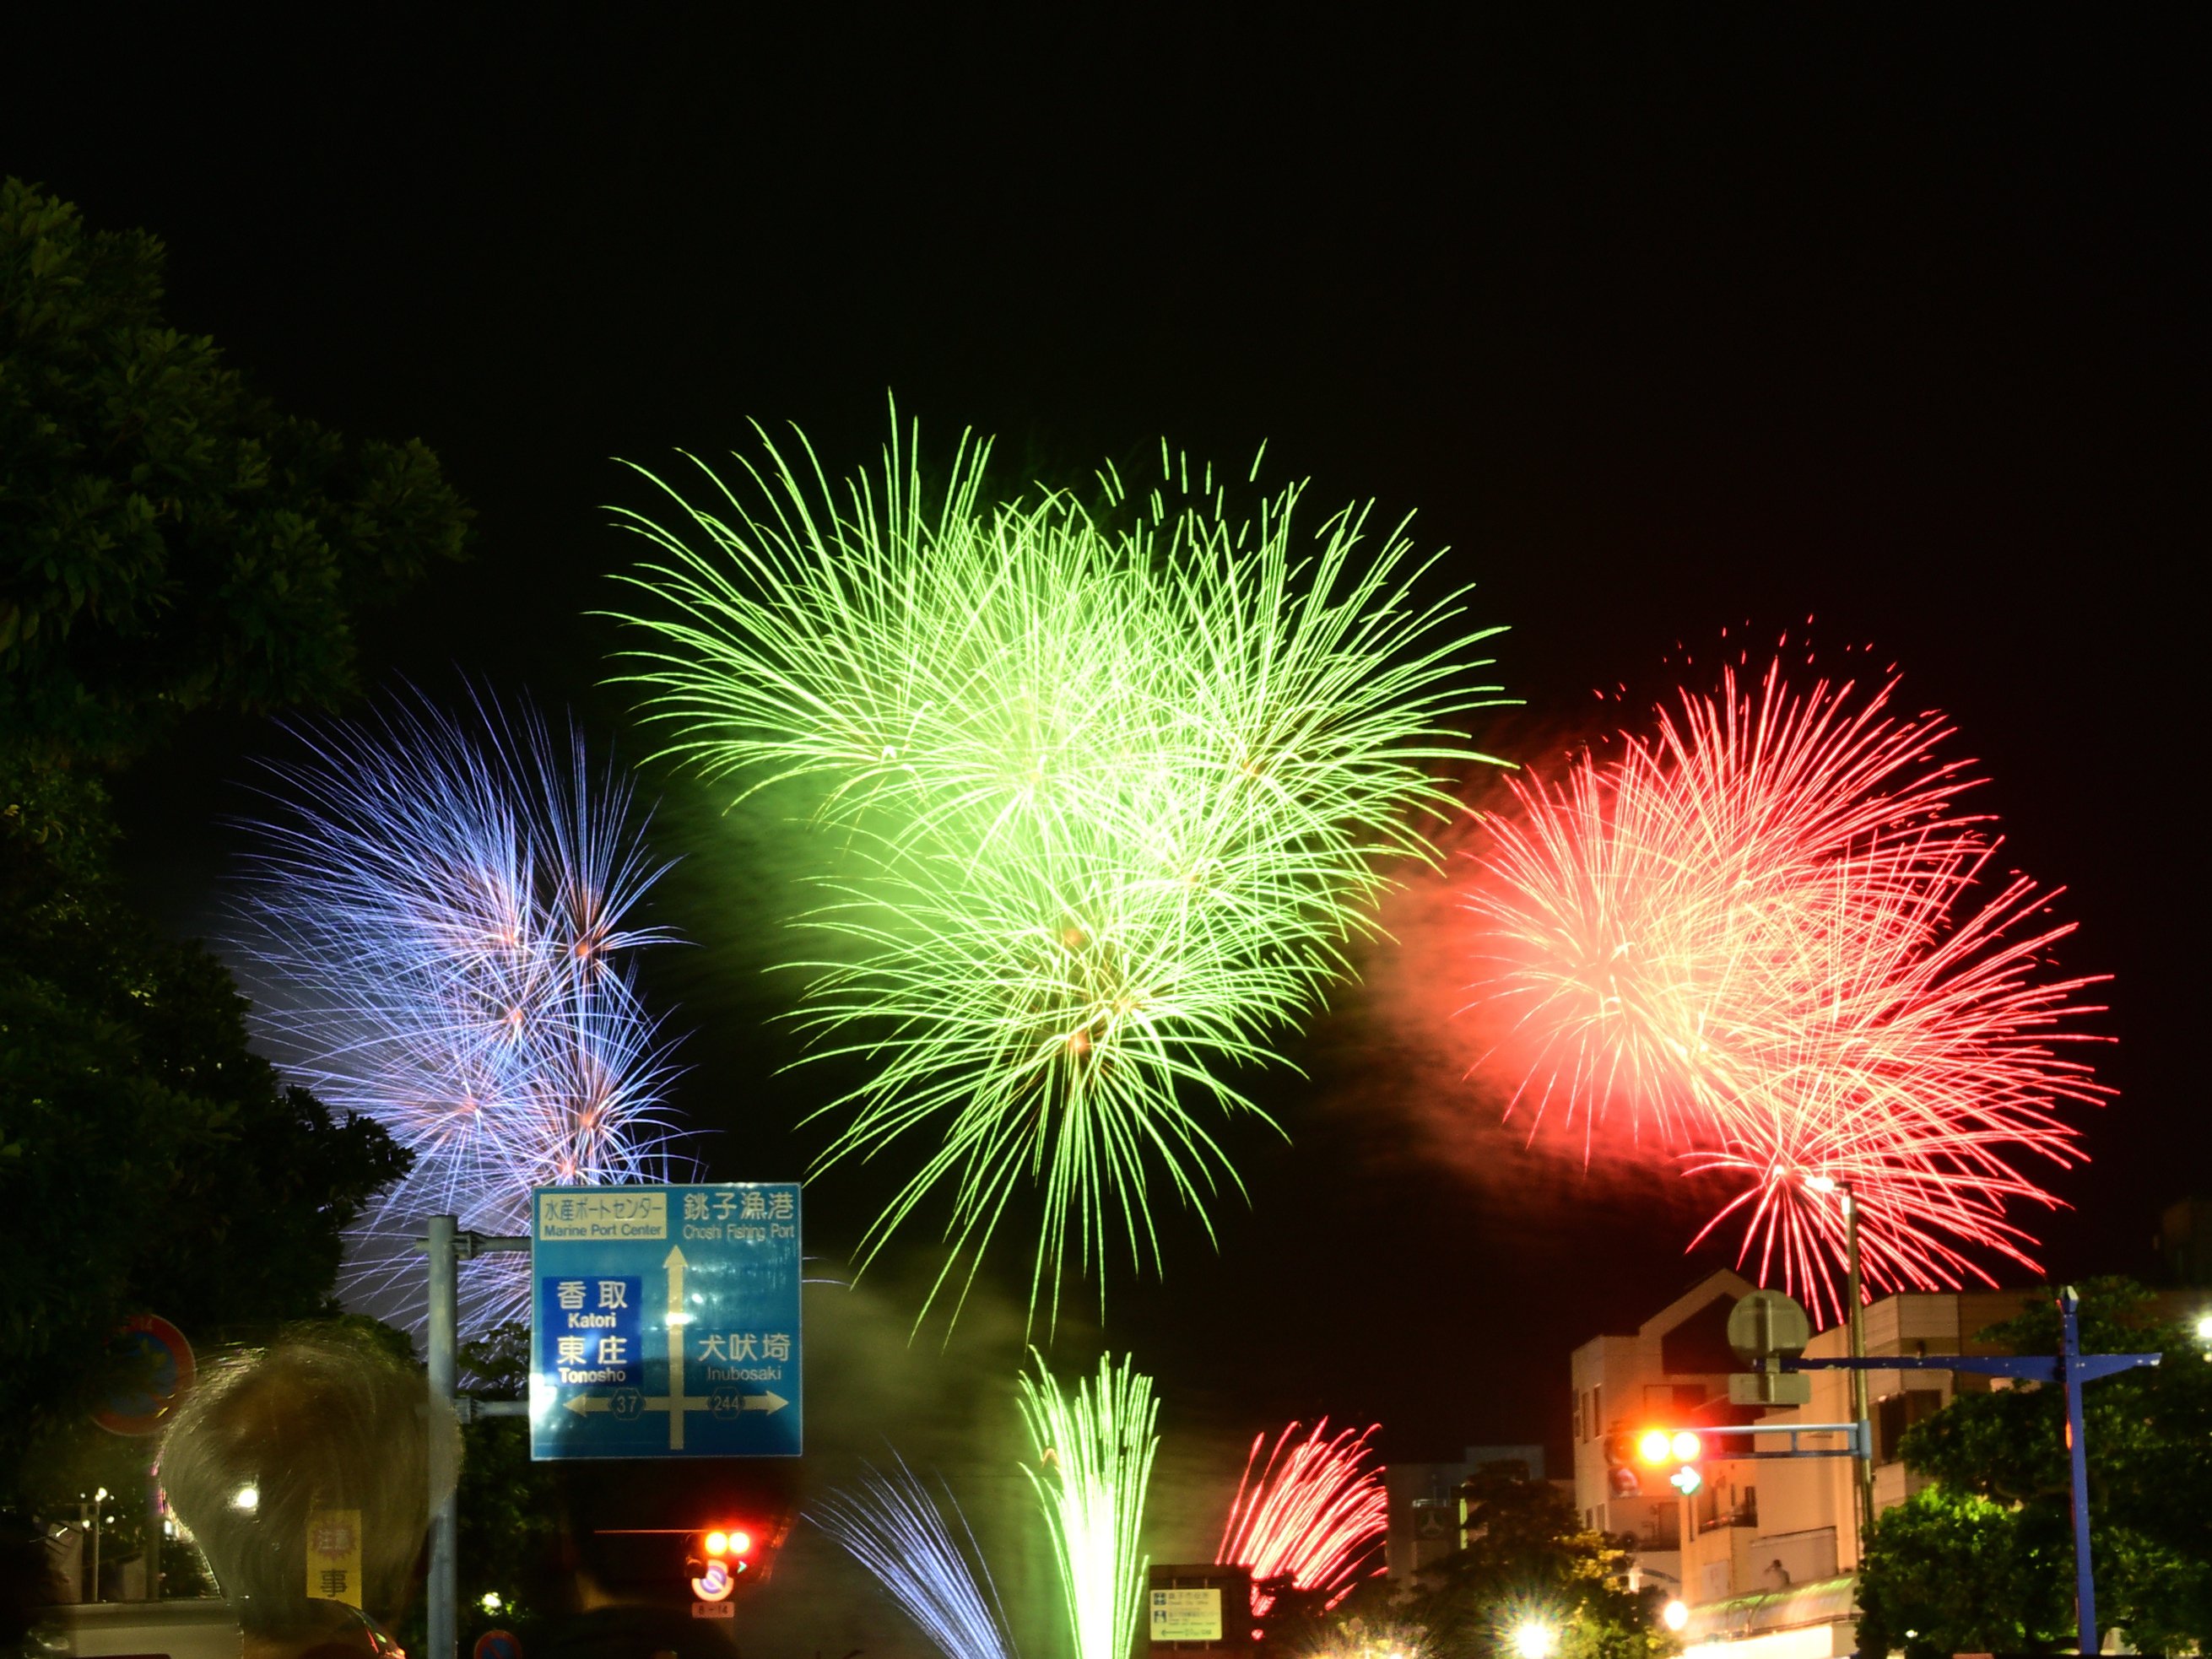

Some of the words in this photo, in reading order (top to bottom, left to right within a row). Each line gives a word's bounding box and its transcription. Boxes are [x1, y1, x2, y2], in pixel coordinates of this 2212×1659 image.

[684, 1192, 794, 1220] 銚子漁港
[544, 1224, 587, 1237] Marine
[592, 1224, 616, 1235] Port
[621, 1224, 663, 1235] Center
[683, 1224, 722, 1240] Choshi
[727, 1223, 766, 1241] Fishing
[770, 1223, 795, 1238] Port
[557, 1281, 628, 1310] 香取
[568, 1311, 617, 1328] Katori
[557, 1335, 628, 1365] 東庄
[698, 1332, 792, 1362] 犬吠埼
[558, 1367, 626, 1383] Tonosho
[708, 1365, 782, 1381] Inubosaki
[617, 1396, 637, 1413] 37
[713, 1395, 739, 1411] 244
